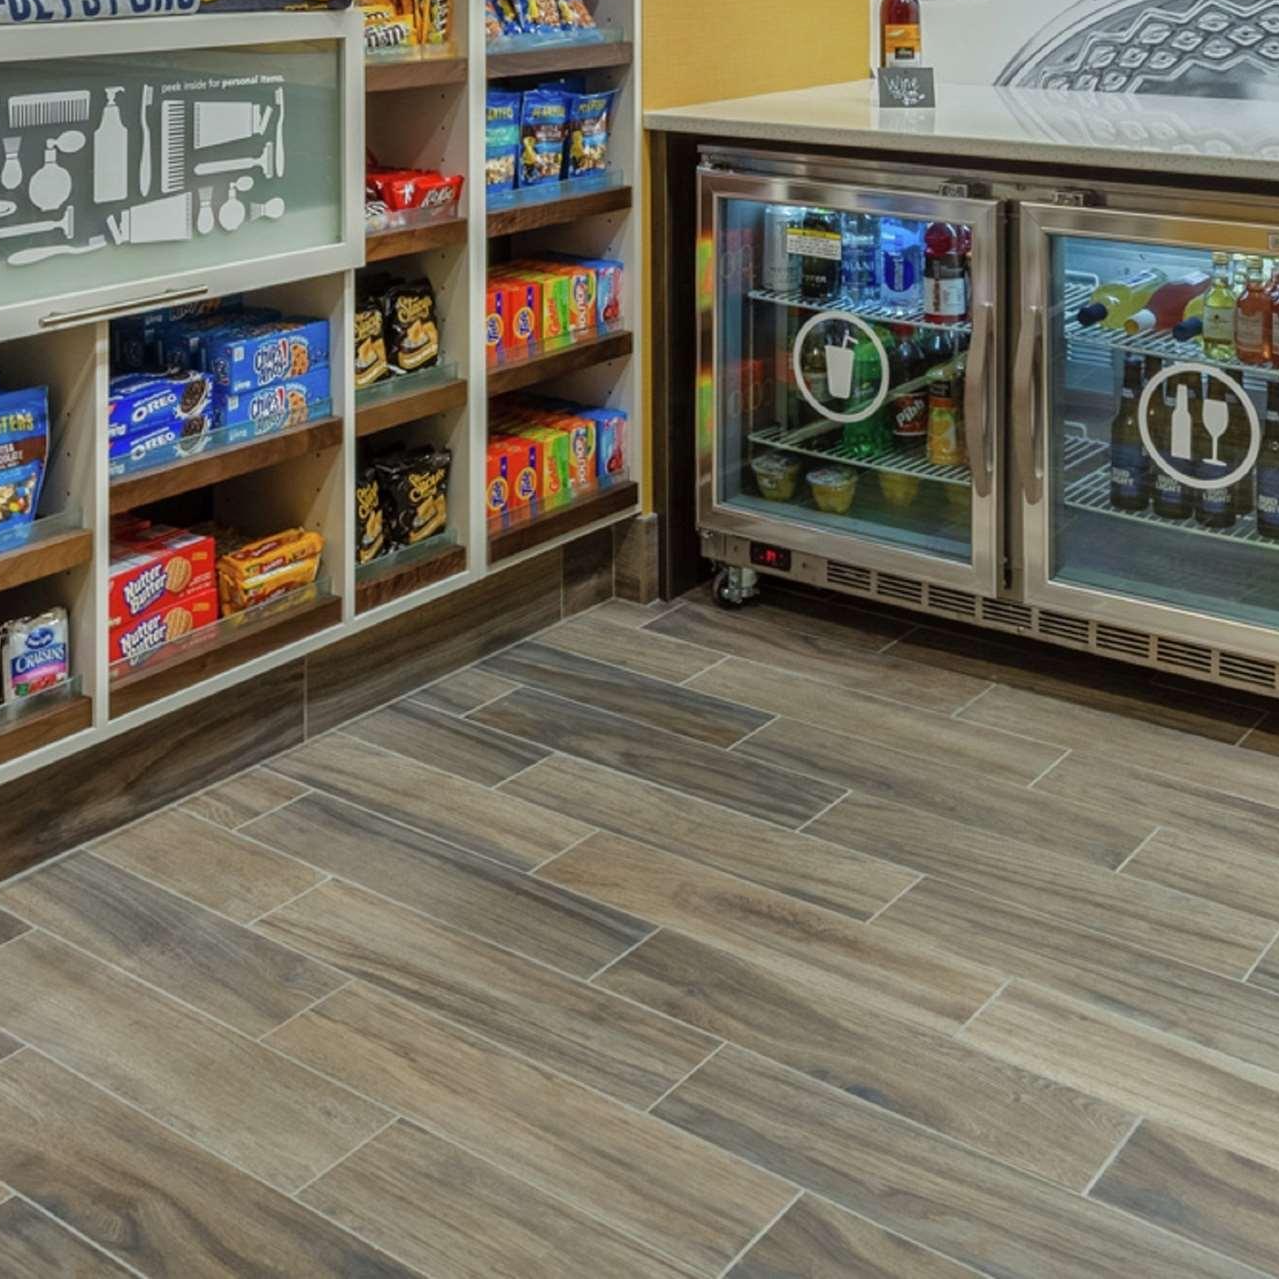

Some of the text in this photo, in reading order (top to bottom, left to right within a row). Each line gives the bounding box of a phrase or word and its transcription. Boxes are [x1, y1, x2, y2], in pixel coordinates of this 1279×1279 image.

[161, 81, 182, 94] peek
[184, 79, 207, 91] inside
[209, 77, 221, 89] for
[222, 74, 259, 90] personal
[131, 392, 177, 423] OREO
[129, 431, 176, 461] OREO
